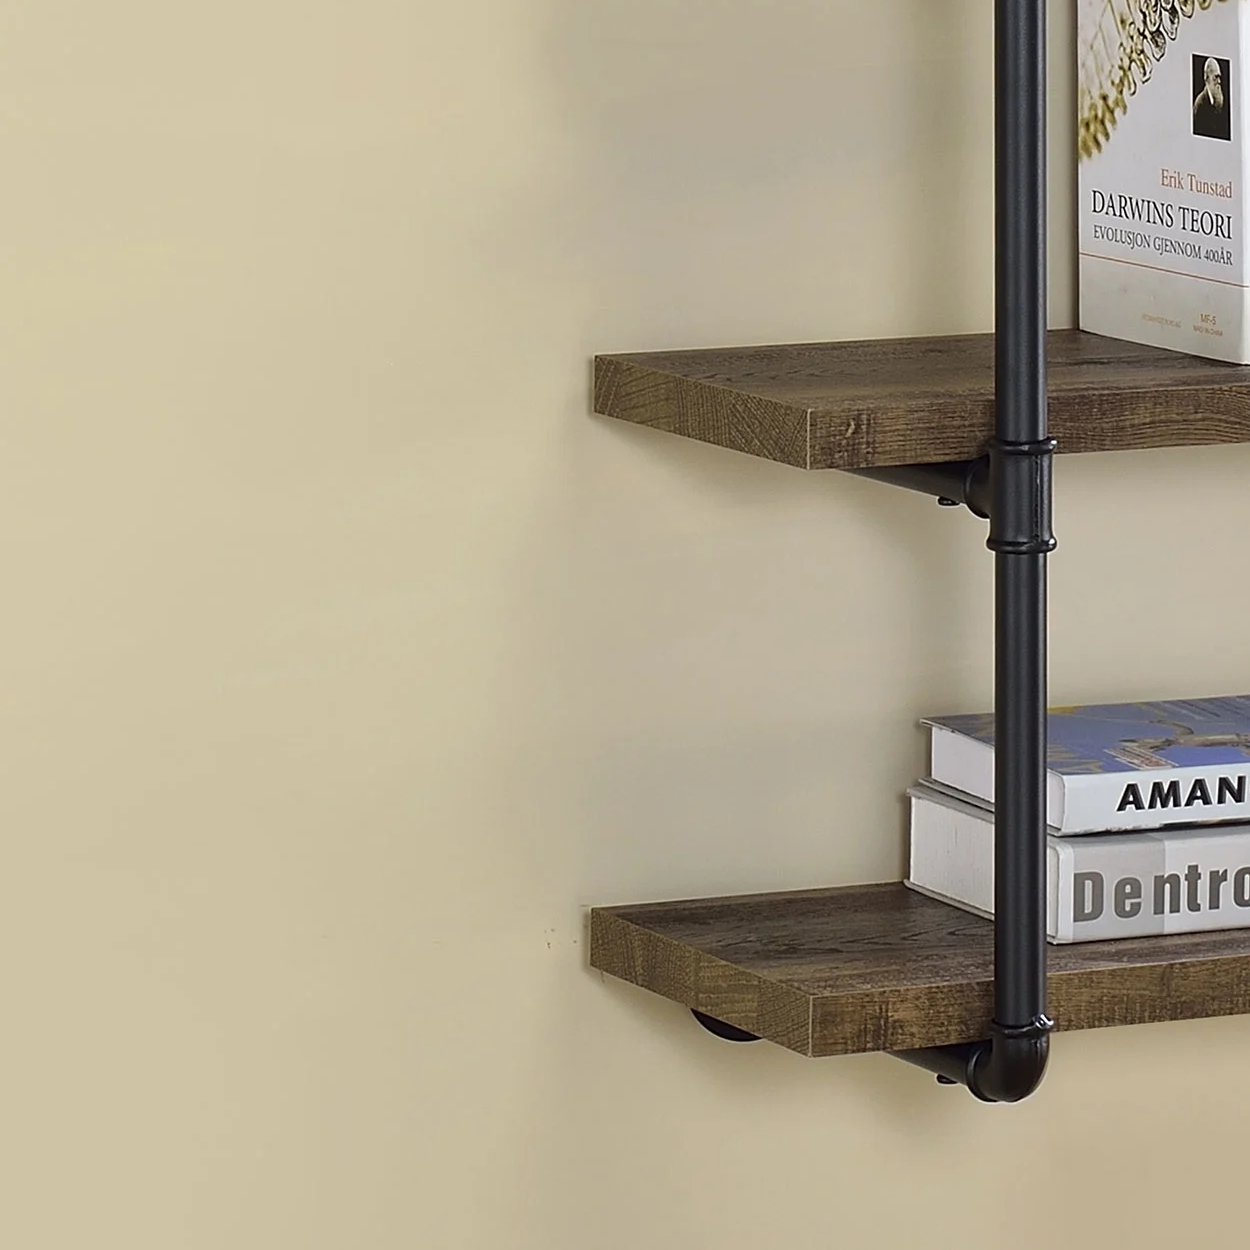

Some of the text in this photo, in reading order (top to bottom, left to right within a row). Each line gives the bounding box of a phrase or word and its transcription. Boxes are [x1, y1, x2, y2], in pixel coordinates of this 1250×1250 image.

[1161, 168, 1233, 199] Erik Tunstad
[1091, 189, 1233, 240] DARWINS TEORI
[1093, 224, 1233, 267] EVOLUSJON GJENNOM 400ÅR
